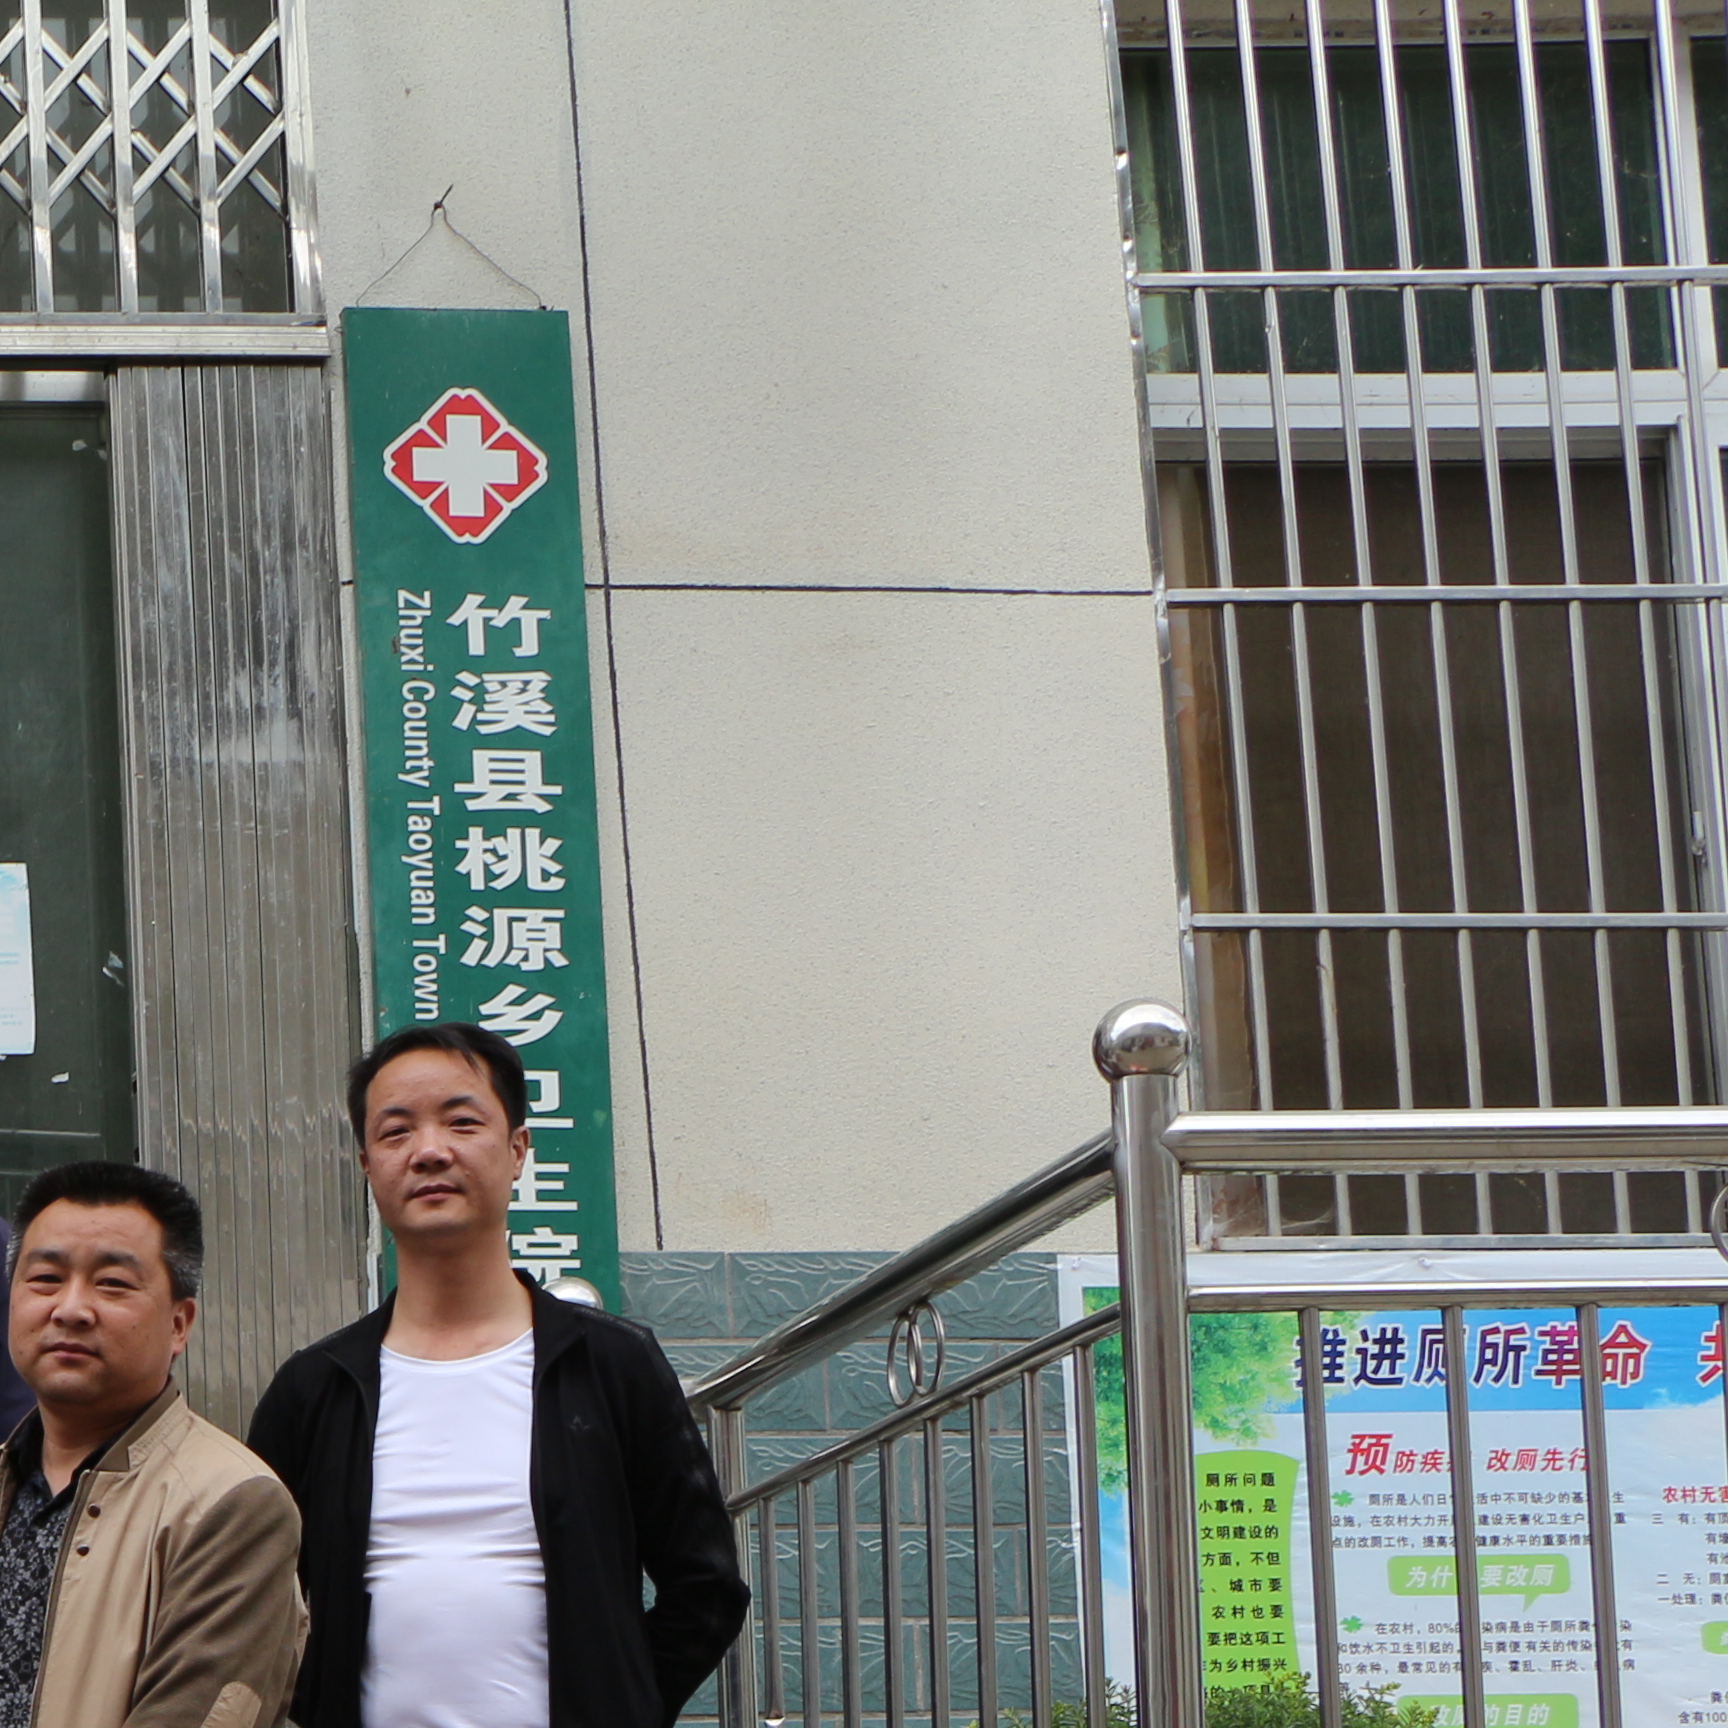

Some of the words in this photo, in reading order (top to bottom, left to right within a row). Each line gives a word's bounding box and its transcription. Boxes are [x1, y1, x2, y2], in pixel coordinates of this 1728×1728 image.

[396, 589, 431, 673] Zhuxi
[395, 678, 436, 787] County
[403, 796, 442, 927] Taoyuan
[408, 932, 444, 1022] Town
[1205, 1472, 1275, 1487] 厕所问题
[1198, 1499, 1277, 1513] 小事情，是
[1201, 1525, 1279, 1540] 文明建设的
[1202, 1552, 1281, 1567] 方面，不但
[1211, 1604, 1284, 1619] 农村也要
[1207, 1631, 1286, 1647] 要把这项工
